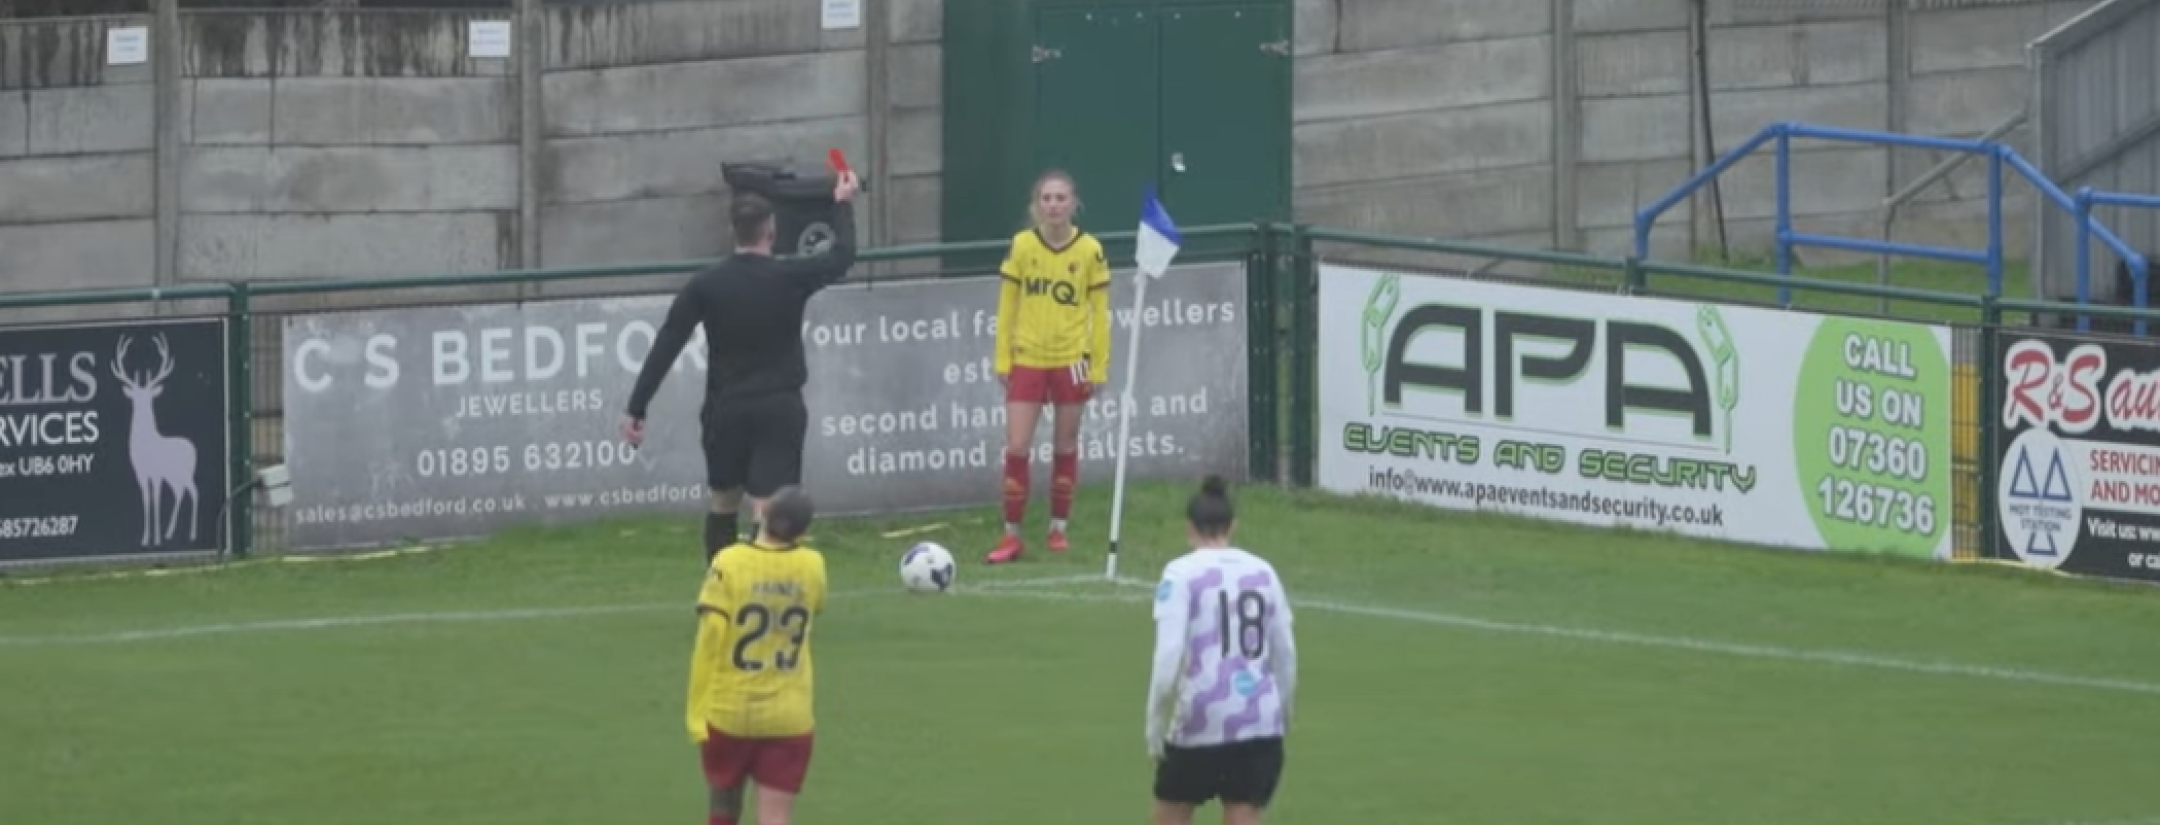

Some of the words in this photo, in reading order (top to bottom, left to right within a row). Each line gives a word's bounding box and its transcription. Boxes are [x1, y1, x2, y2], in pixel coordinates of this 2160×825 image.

[879, 305, 961, 343] local
[293, 339, 334, 392] C
[363, 333, 401, 390] S
[432, 318, 710, 386] BEDFOR
[1383, 303, 1713, 438] APA
[1844, 334, 1917, 379] CALL
[455, 388, 604, 419] JEWELLERS
[821, 401, 938, 437] second
[951, 404, 1008, 428] han
[1150, 388, 1209, 417] and
[1836, 379, 1872, 420] US
[1881, 389, 1923, 427] ON
[18, 456, 54, 476] UB6
[416, 445, 511, 477] 01895
[523, 439, 637, 472] 632100
[847, 442, 986, 476] diamond
[1494, 440, 1565, 475] AND
[1579, 449, 1757, 494] SECURITY
[1829, 426, 1926, 481] 07360
[295, 494, 526, 525] sales@csbedford.co.uk
[1818, 476, 1935, 535] 126736
[2090, 479, 2130, 504] AND
[733, 604, 809, 671] 23
[1219, 589, 1266, 661] 18
